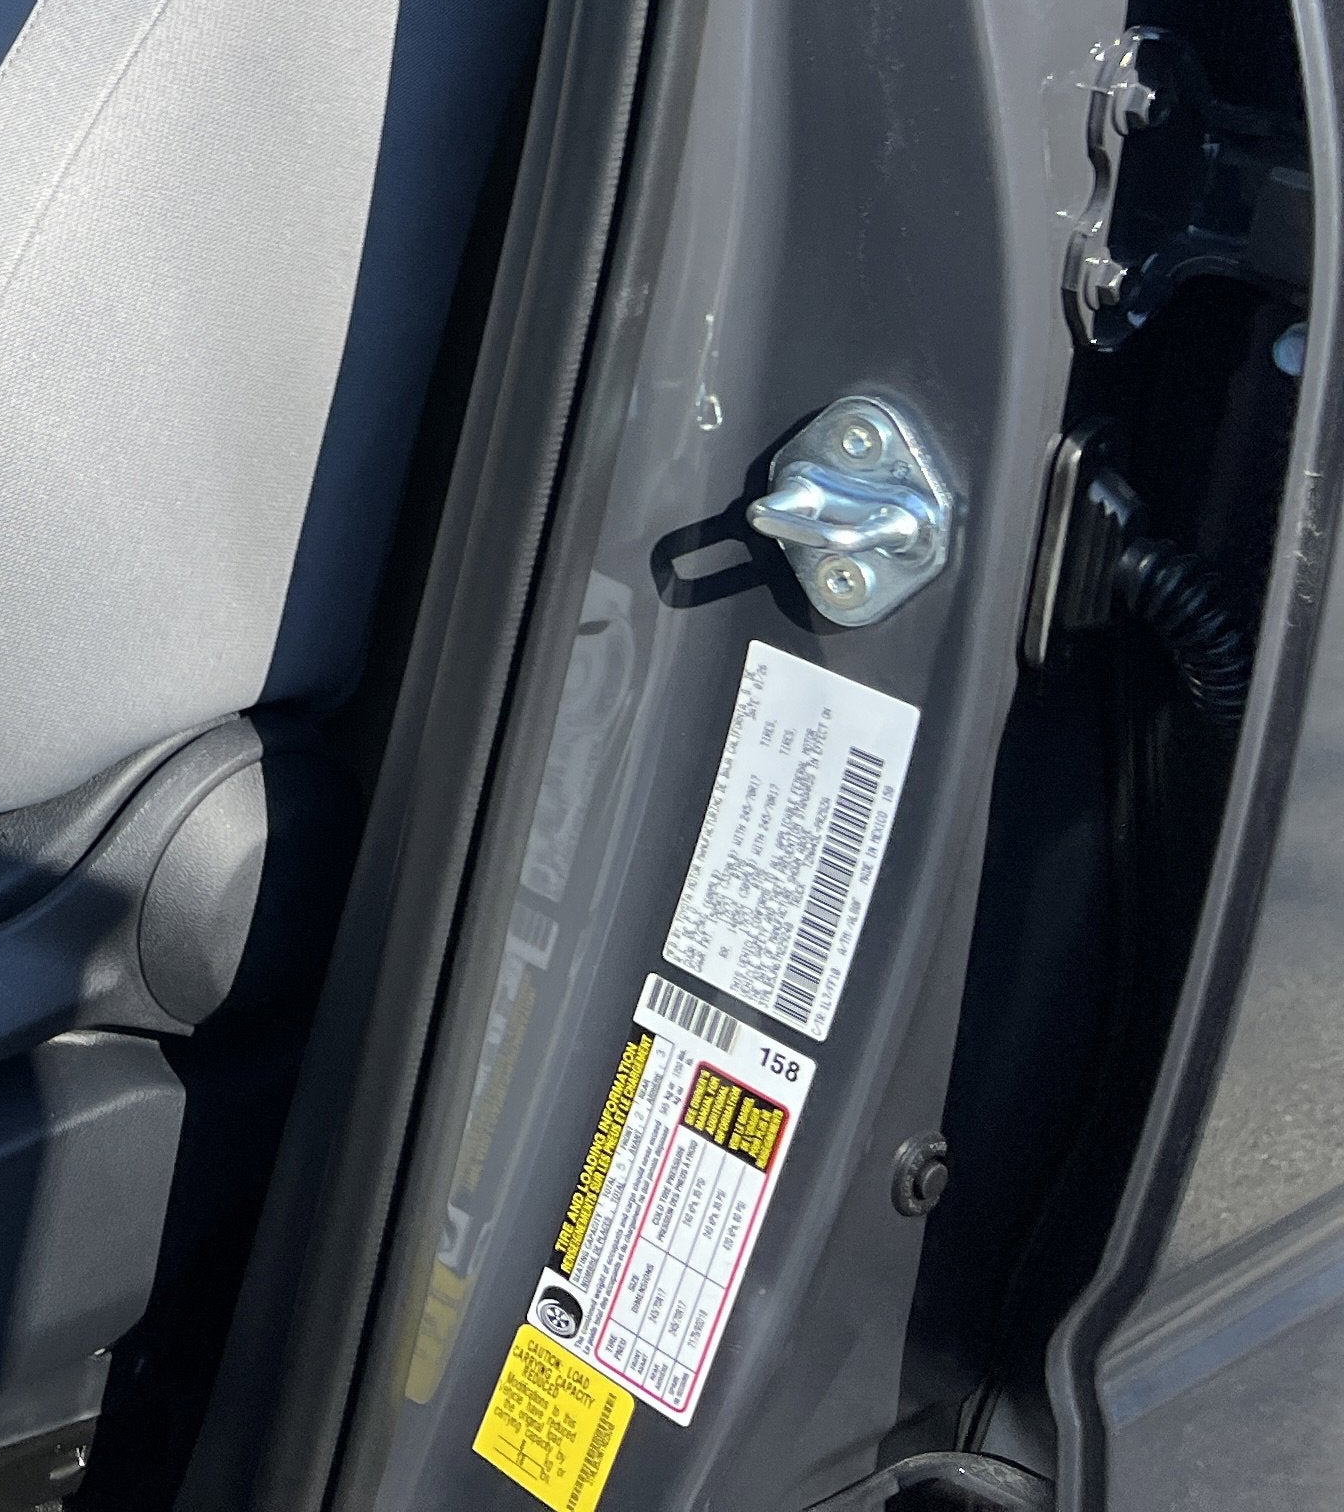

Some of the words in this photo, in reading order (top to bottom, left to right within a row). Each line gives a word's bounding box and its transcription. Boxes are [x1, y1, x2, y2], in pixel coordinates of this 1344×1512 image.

[799, 726, 816, 756] MOTOR
[811, 721, 829, 754] EFFECT
[820, 705, 833, 720] ON
[788, 758, 808, 796] FEDERAL
[694, 794, 723, 863] MANUFACTURING
[731, 821, 747, 847] WITH
[773, 796, 798, 851] APPLICABLE
[868, 808, 889, 845] MEXICO
[750, 830, 767, 856] WITH
[864, 843, 879, 859] IN
[767, 851, 782, 870] ALL
[857, 860, 874, 886] MADE
[686, 862, 703, 893] MOTOR
[676, 891, 694, 926] TOYOTA
[737, 930, 758, 971] VEHICLE
[730, 969, 745, 994] THIS
[622, 1032, 654, 1099] CHARGEMENT
[654, 1047, 666, 1059] 3
[758, 1045, 801, 1083] 158
[597, 1039, 638, 1134] INFORMATION
[637, 1077, 651, 1100] REAR
[662, 1088, 674, 1102] kg
[618, 1095, 632, 1112] LE
[632, 1109, 645, 1121] 2
[683, 1105, 698, 1126] SEE
[693, 1093, 714, 1131] MANUAL
[705, 1074, 721, 1096] FOR
[703, 1081, 730, 1136] ADDITIONAL
[712, 1083, 742, 1146] INFORMATION
[613, 1109, 627, 1125] ET
[603, 1121, 623, 1155] PNEUS
[618, 1123, 634, 1150] FRONT
[627, 1128, 643, 1155] AVANT
[646, 1118, 662, 1146] exceed
[575, 1130, 607, 1193] LOADING
[595, 1151, 612, 1173] LES
[640, 1145, 653, 1167] never
[683, 1137, 699, 1163] FROID
[630, 1164, 645, 1192] should
[664, 1143, 686, 1186] PRESSURE
[588, 1169, 605, 1193] SUR
[602, 1174, 616, 1199] TOTAL
[609, 1179, 625, 1205] TOTAL
[673, 1166, 688, 1193] PNEUS
[565, 1190, 586, 1224] AND
[623, 1190, 639, 1215] cargo
[658, 1184, 672, 1204] TIRE
[668, 1190, 680, 1208] DES
[617, 1211, 629, 1228] and
[650, 1202, 666, 1227] COLD
[655, 1204, 675, 1243] PRESSION
[554, 1220, 575, 1255] TIRE
[559, 1189, 598, 1275] RENSEIGNEMENTS
[583, 1210, 603, 1251] CAPACITY
[595, 1214, 612, 1245] PLACES
[591, 1243, 602, 1256] DE
[604, 1226, 624, 1267] occupants
[572, 1248, 590, 1284] SEATING
[580, 1255, 598, 1289] NOMBRE
[600, 1263, 610, 1275] of
[591, 1272, 608, 1301] weight
[627, 1272, 640, 1293] SIZE
[630, 1261, 655, 1315] DIMENSIONS
[578, 1298, 598, 1336] combined
[592, 1307, 604, 1327] total
[586, 1324, 600, 1347] poids
[604, 1332, 618, 1354] TIRE
[613, 1336, 628, 1361] PNEU
[511, 1343, 553, 1380] CARRYING
[553, 1373, 595, 1410] CAPACITY
[520, 1364, 561, 1400] REDUCED
[565, 1365, 591, 1391] LOAD
[497, 1380, 525, 1405] vehicle
[525, 1401, 545, 1420] have
[545, 1414, 577, 1444] reduced
[504, 1370, 551, 1410] Modifications
[551, 1404, 561, 1417] to
[562, 1412, 578, 1429] this
[491, 1405, 523, 1434] carrying
[522, 1426, 554, 1458] capacity
[502, 1398, 516, 1413] the
[515, 1407, 545, 1436] original
[544, 1427, 563, 1447] load
